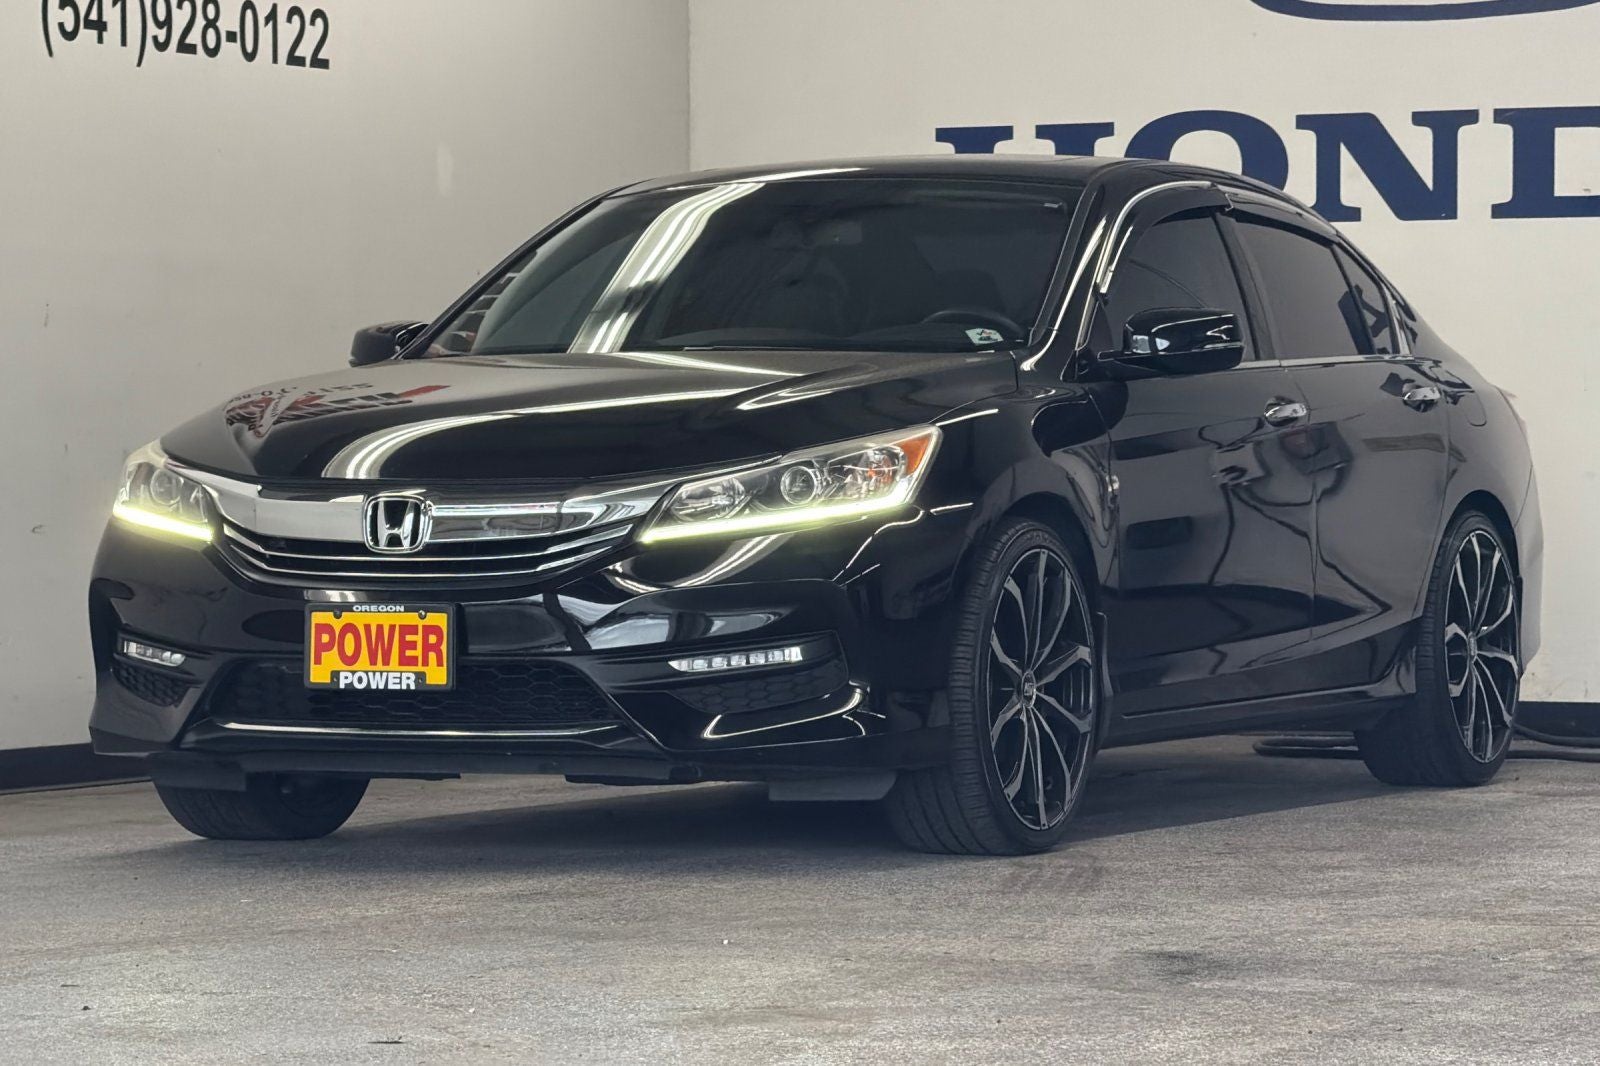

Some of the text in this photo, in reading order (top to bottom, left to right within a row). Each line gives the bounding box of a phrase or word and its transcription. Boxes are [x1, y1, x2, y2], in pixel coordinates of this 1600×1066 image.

[42, 0, 330, 69] (541)928-0122
[313, 622, 445, 667] POWER
[339, 671, 416, 690] POWER
